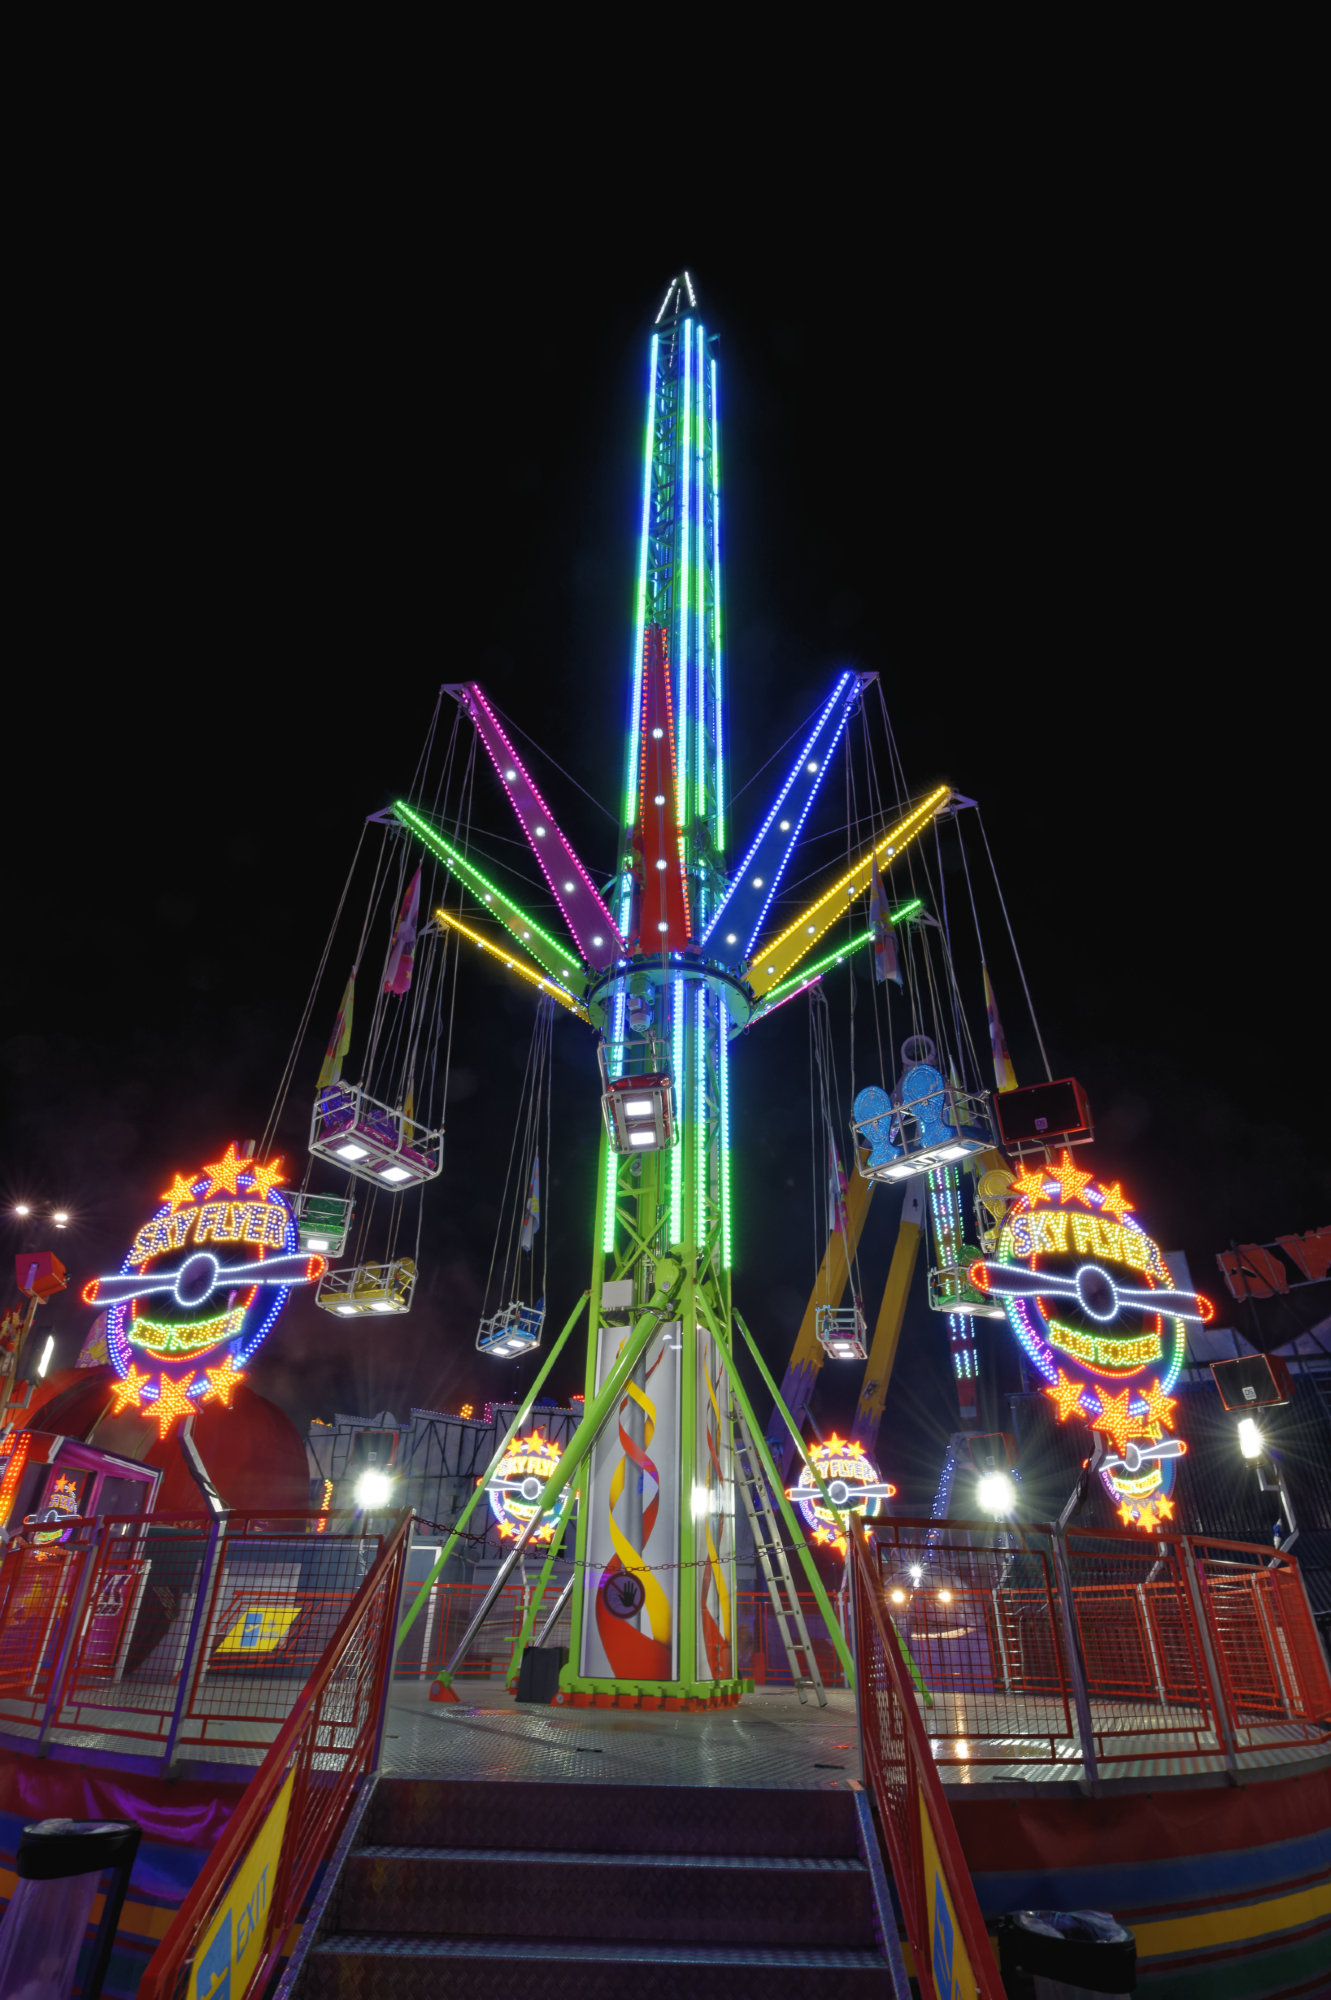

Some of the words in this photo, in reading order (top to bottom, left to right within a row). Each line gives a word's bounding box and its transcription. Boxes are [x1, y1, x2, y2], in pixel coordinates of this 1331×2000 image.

[129, 1206, 199, 1265] SKY
[193, 1201, 288, 1248] FLYER
[1012, 1210, 1068, 1258] SKY
[1070, 1212, 1168, 1281] FLYER
[1094, 1333, 1163, 1366] TOWER
[497, 1456, 528, 1476] SKY
[801, 1460, 830, 1485] SY
[829, 1459, 874, 1482] FLYER
[236, 1862, 269, 1965] EXIT
